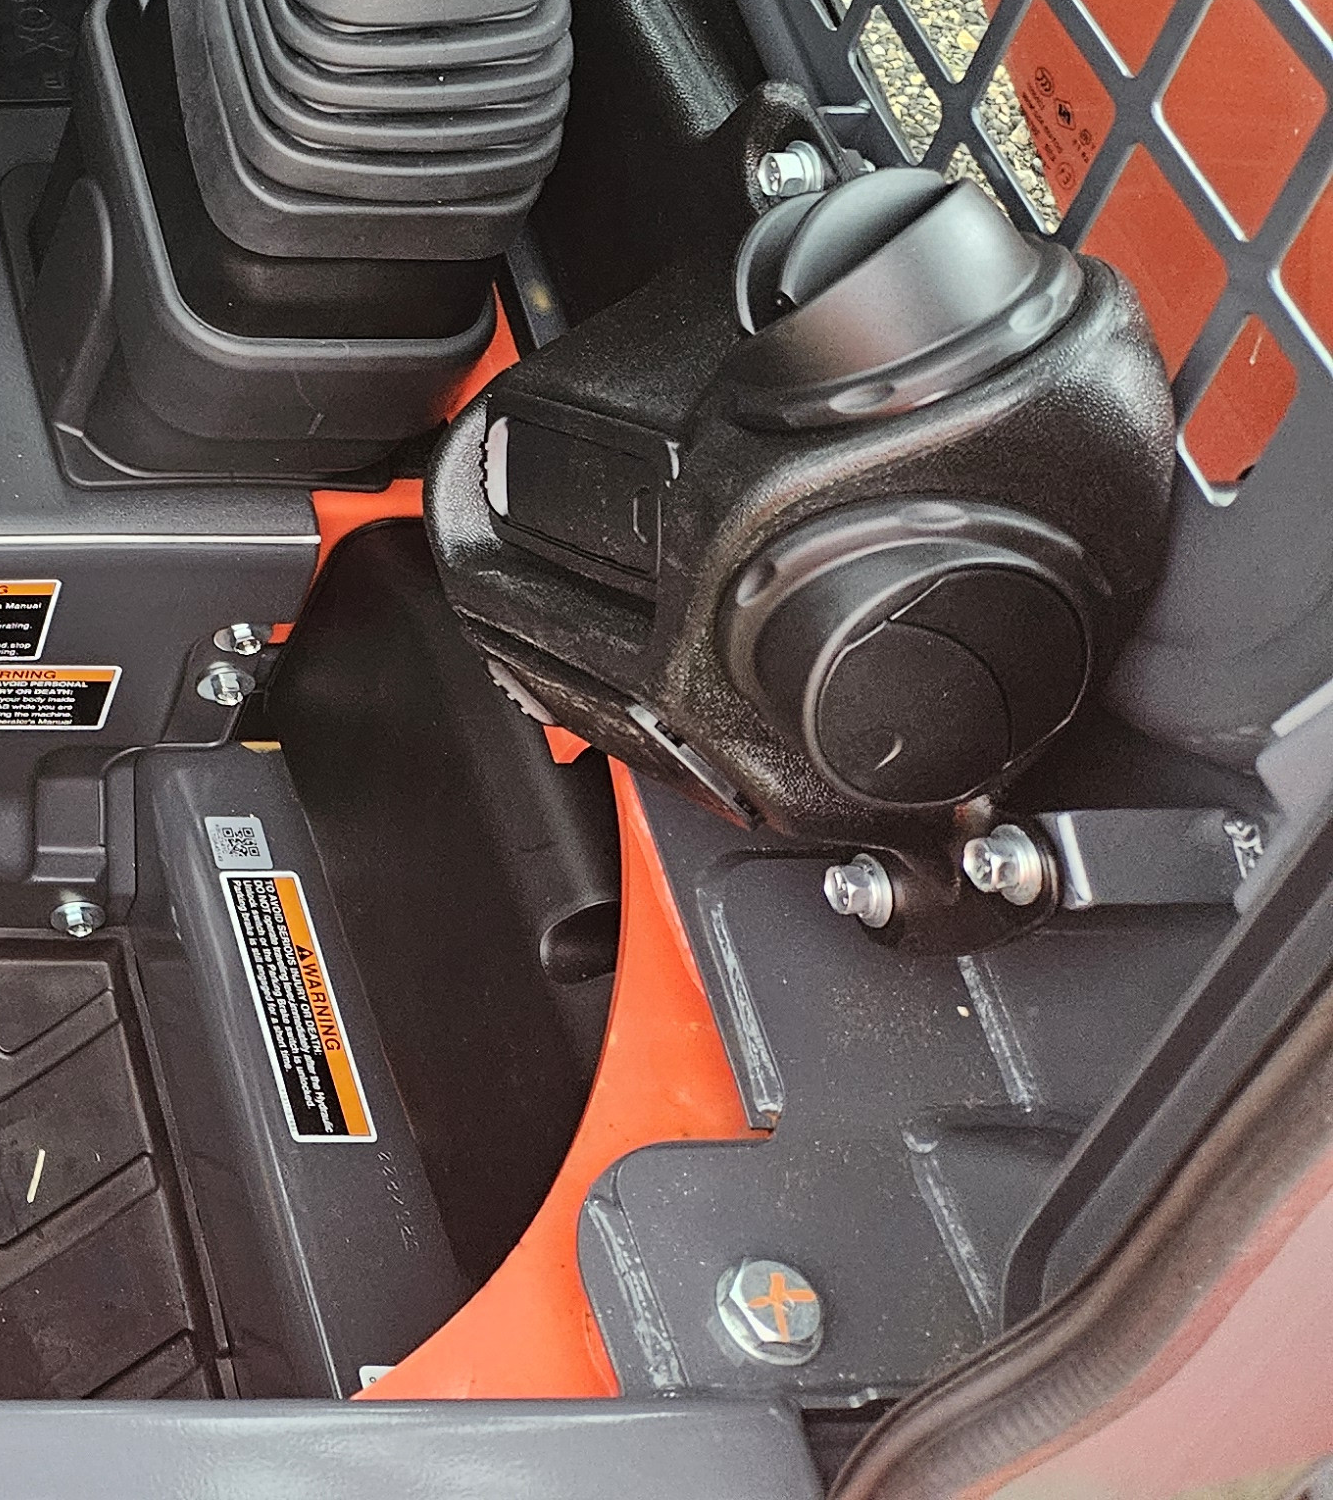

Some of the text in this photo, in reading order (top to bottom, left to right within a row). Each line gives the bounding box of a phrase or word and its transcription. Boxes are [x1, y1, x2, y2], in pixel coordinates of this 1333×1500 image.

[230, 880, 248, 911] Parking
[242, 880, 258, 907] Unlock
[253, 879, 265, 893] DO
[257, 895, 270, 912] NOT
[241, 912, 255, 935] brake
[251, 910, 266, 935] switch
[261, 914, 280, 945] operate
[259, 937, 267, 945] or
[251, 947, 263, 962] still
[262, 948, 273, 961] the
[270, 946, 290, 980] traveling
[263, 881, 323, 1055] TO AVOID SERIOUS INJURY OR DEATH:
[265, 964, 283, 995] Parking
[254, 964, 274, 1001] engaged
[267, 1003, 278, 1015] for
[276, 999, 291, 1023] Brake
[301, 963, 341, 1050] WARNING
[273, 1025, 288, 1047] short
[284, 1026, 300, 1052] switch
[280, 1049, 295, 1072] time.
[304, 1054, 318, 1074] after
[296, 1066, 316, 1108] unlocked.
[310, 1075, 322, 1089] the
[312, 1092, 335, 1132] Hydraulic
